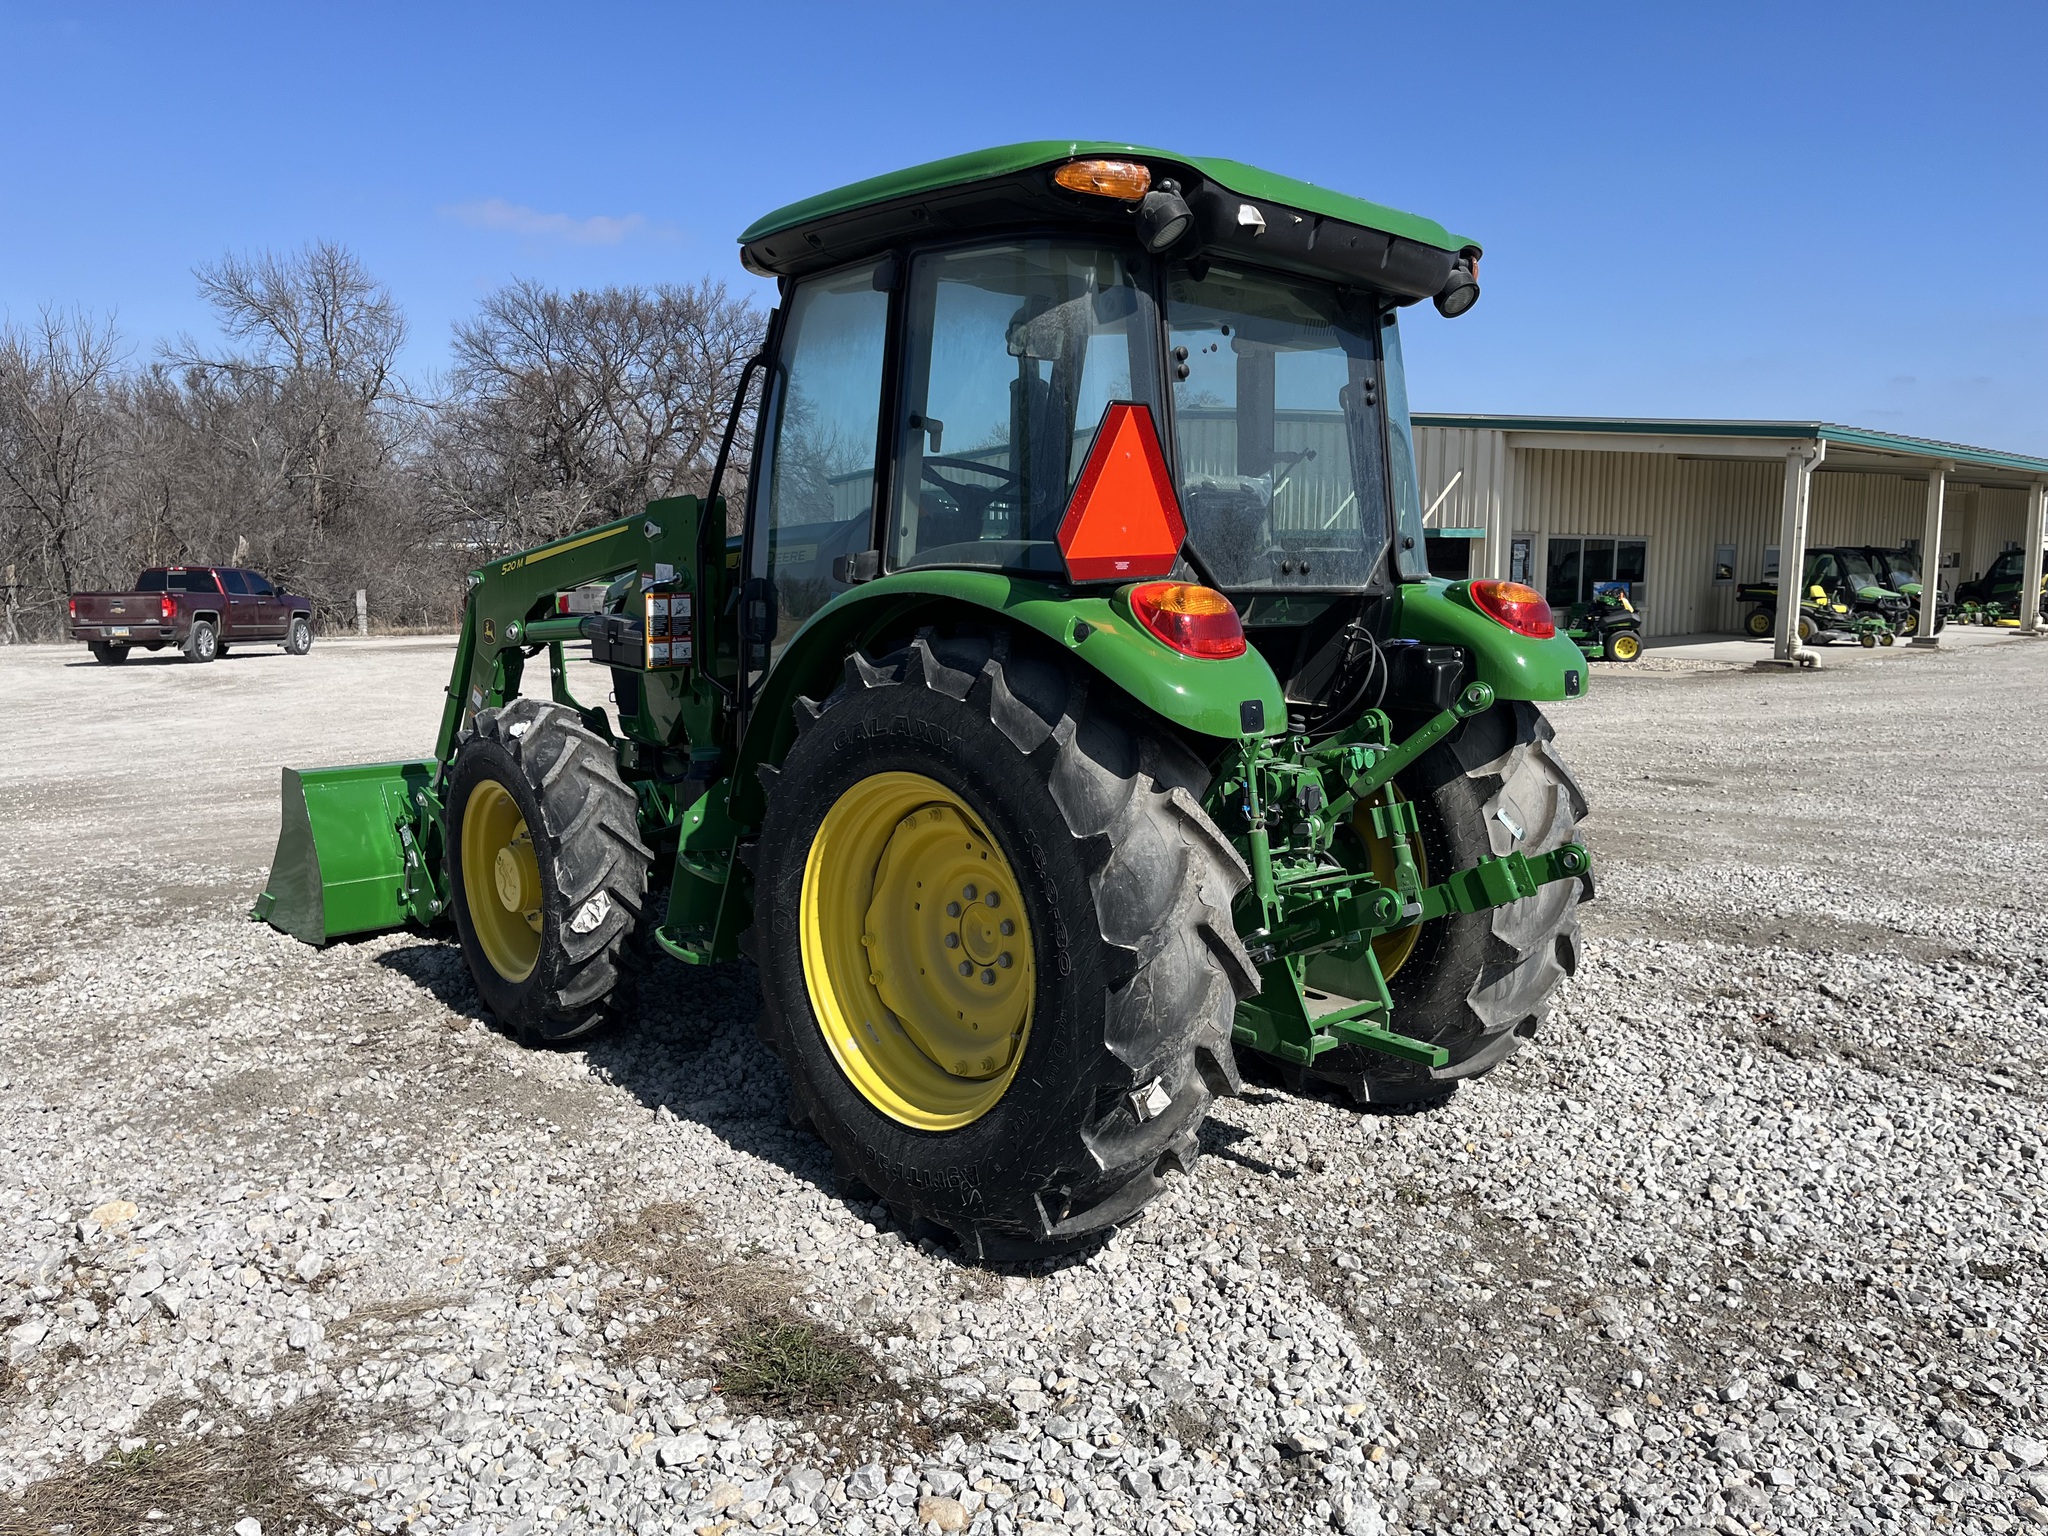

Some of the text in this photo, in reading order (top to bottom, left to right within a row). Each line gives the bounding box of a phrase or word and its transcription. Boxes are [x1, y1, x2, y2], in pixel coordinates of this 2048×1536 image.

[767, 550, 806, 565] DEERE
[501, 561, 516, 575] 520
[833, 714, 963, 753] GALAXY
